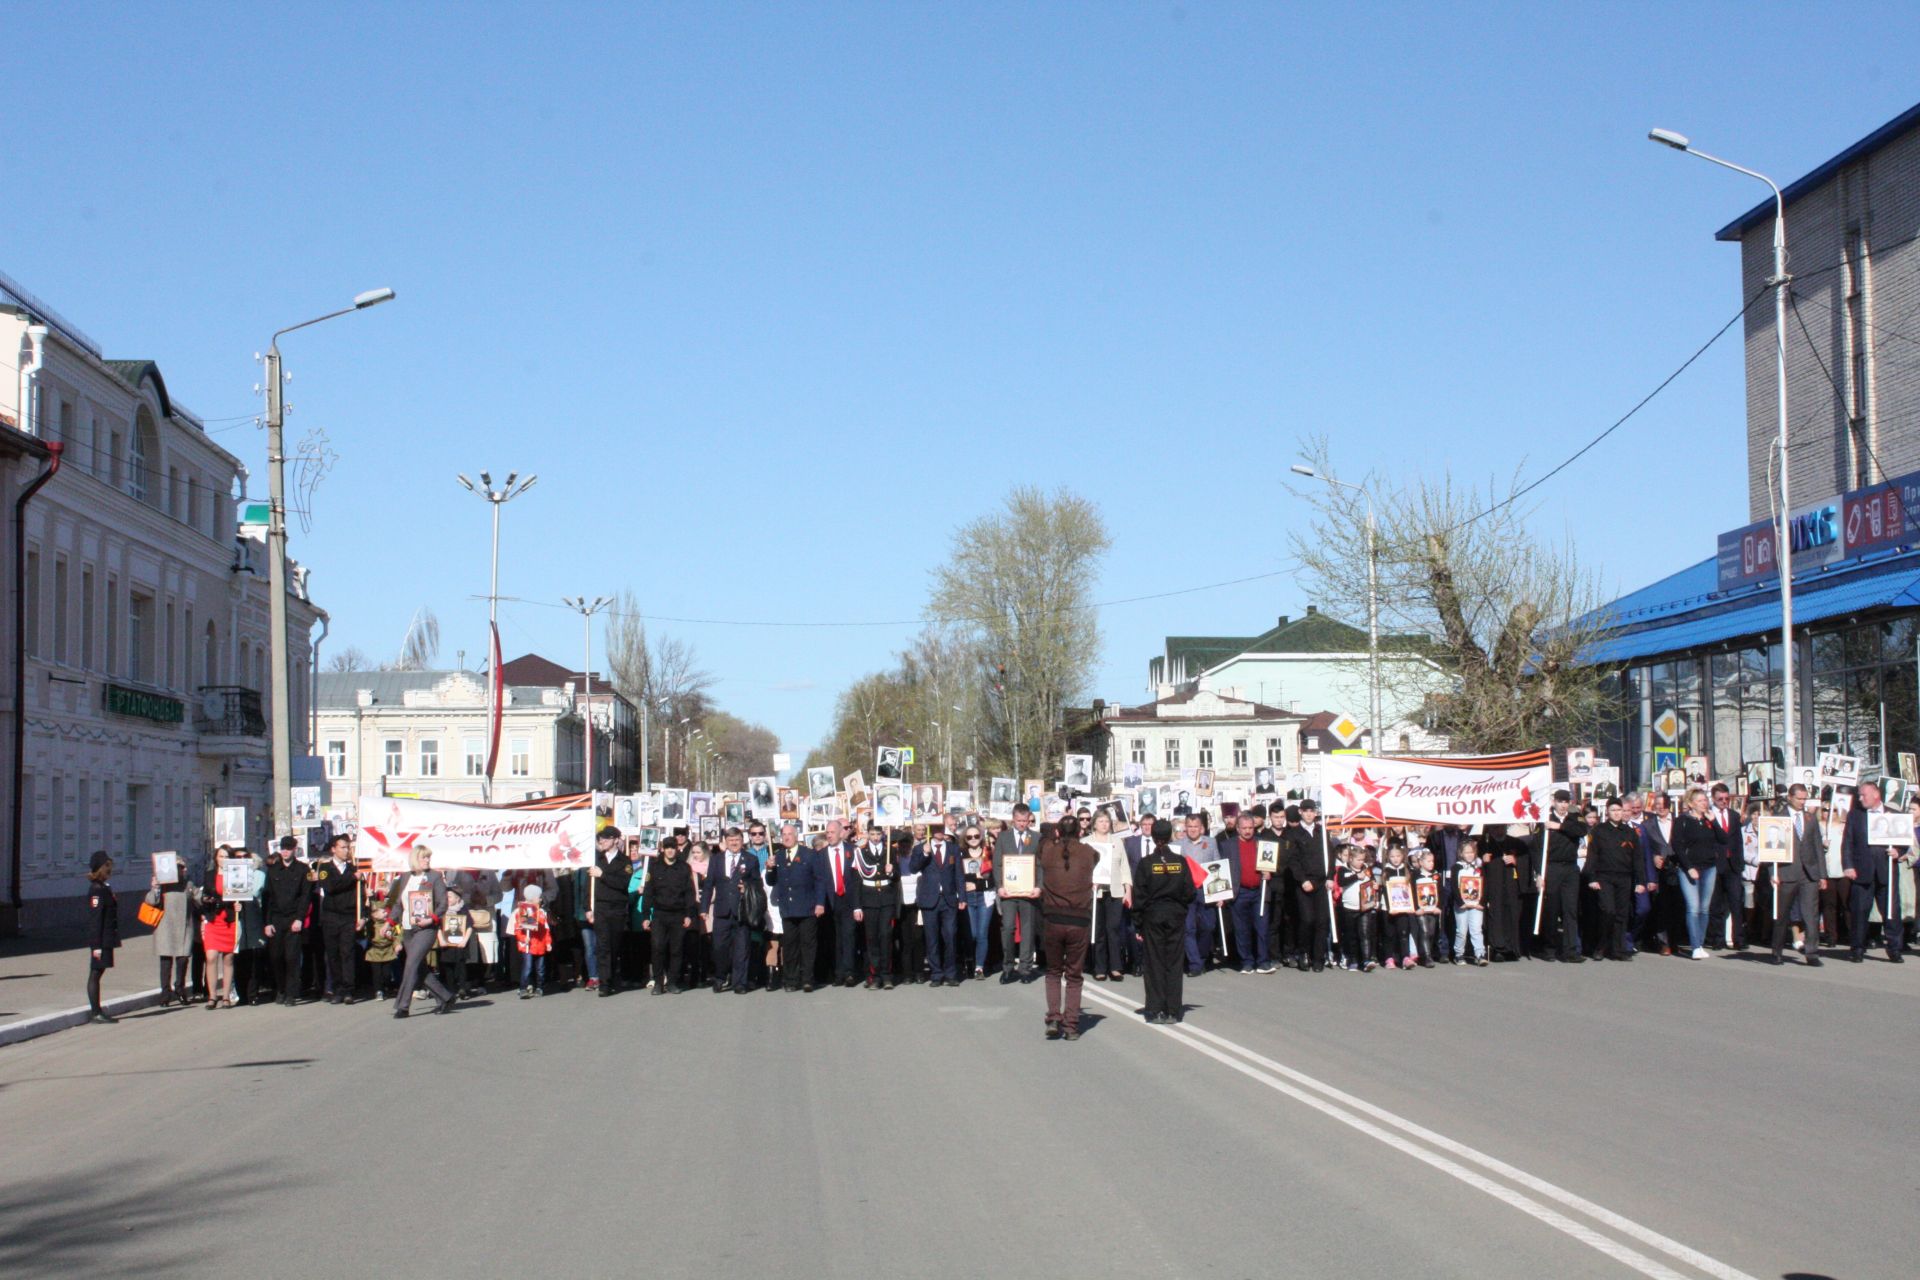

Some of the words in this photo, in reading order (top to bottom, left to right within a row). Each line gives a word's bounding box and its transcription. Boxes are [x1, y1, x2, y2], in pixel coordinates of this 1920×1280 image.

[125, 690, 184, 721] ТАТФОНДБАН
[1394, 771, 1531, 800] Бессмертный
[1436, 799, 1497, 816] ПОЛК
